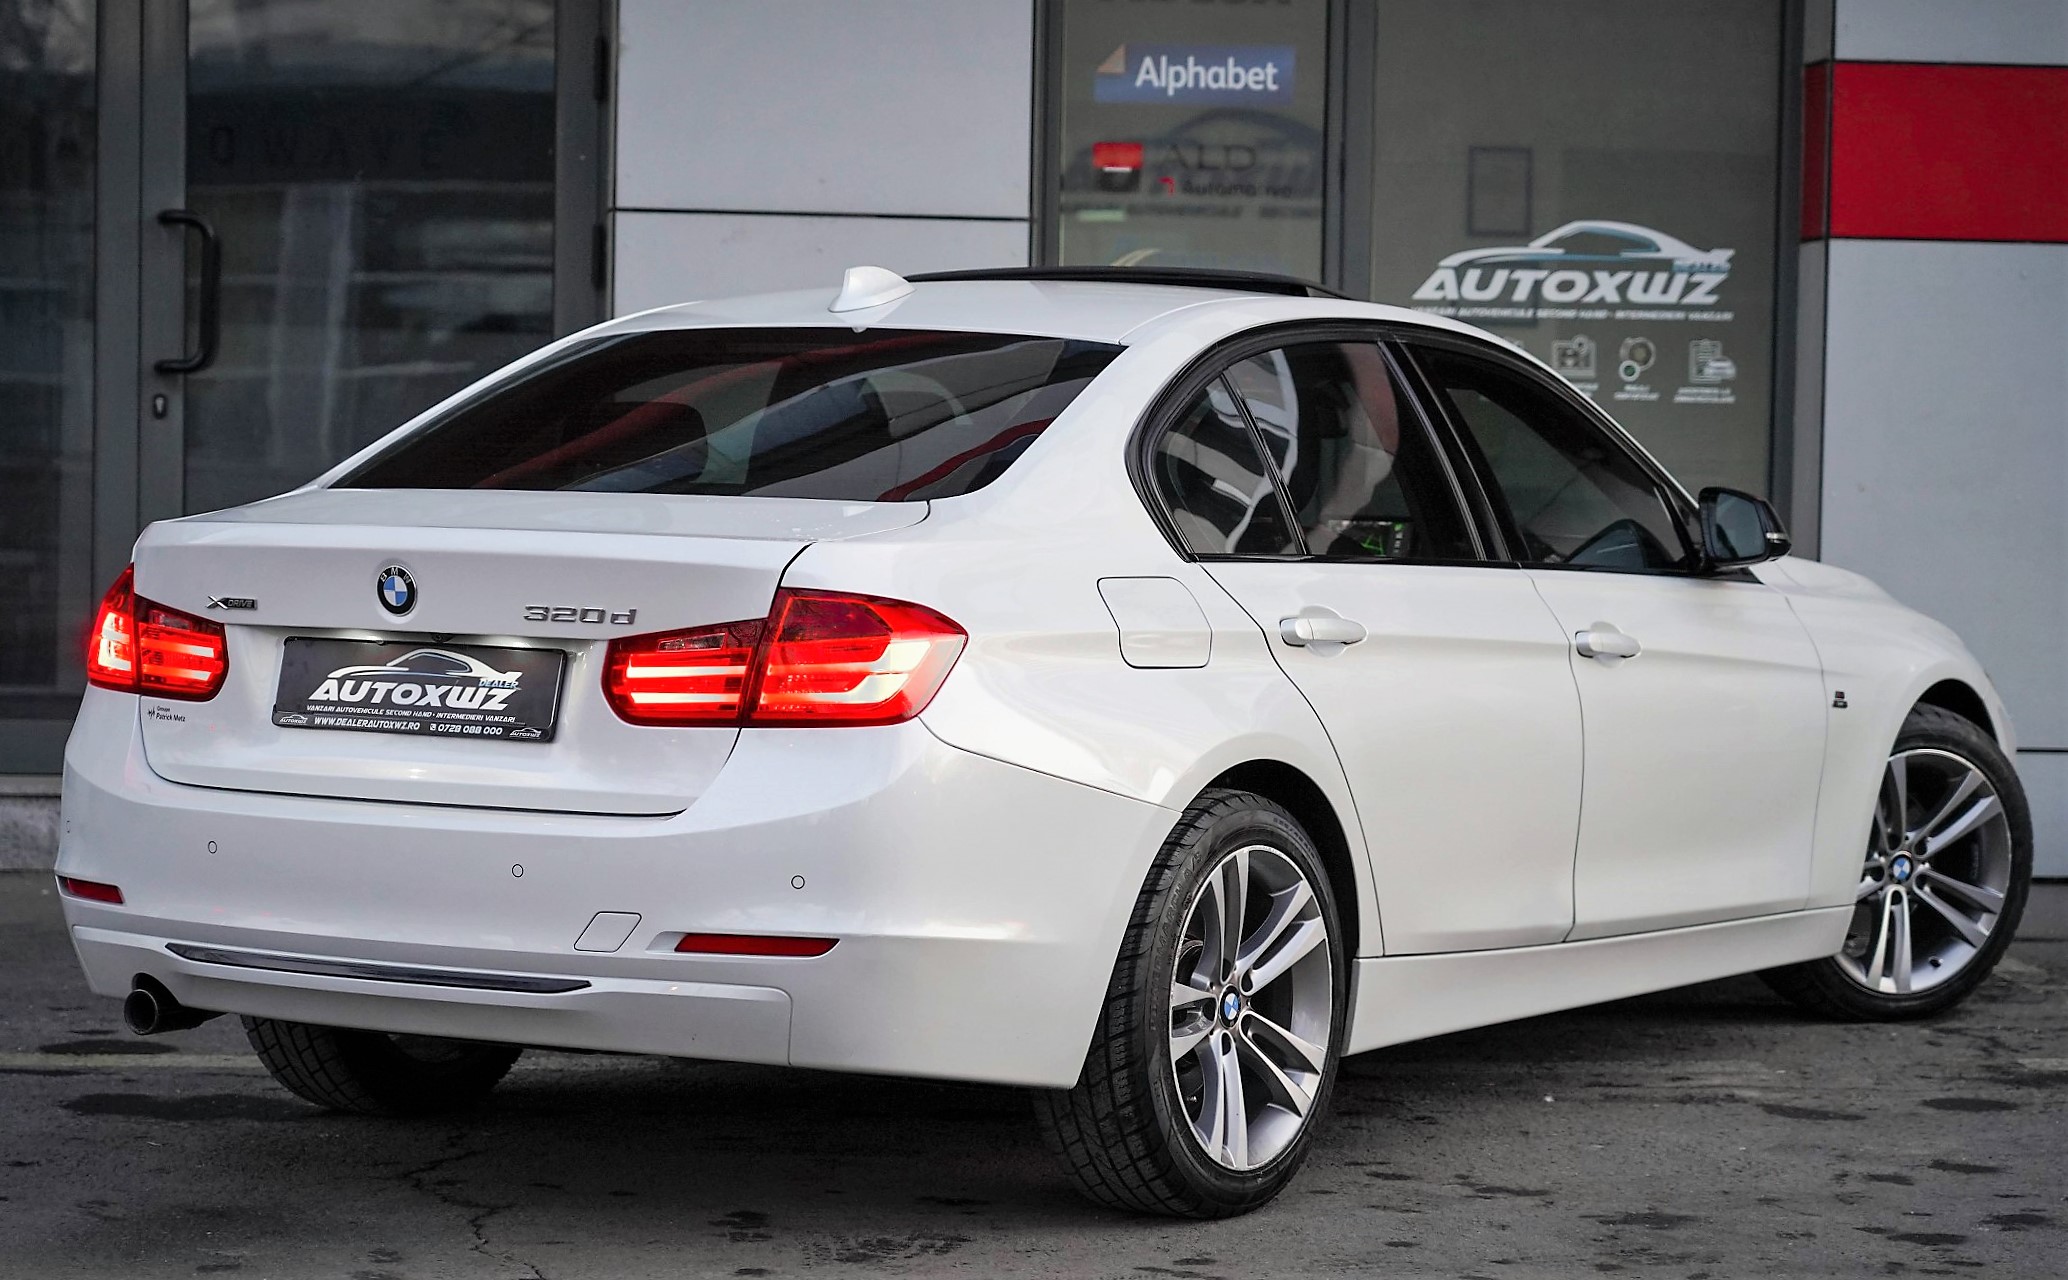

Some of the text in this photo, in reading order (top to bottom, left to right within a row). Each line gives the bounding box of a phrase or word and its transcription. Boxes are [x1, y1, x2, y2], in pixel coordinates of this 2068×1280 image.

[1134, 55, 1279, 96] Alphabet
[1412, 267, 1729, 304] AUTOXWZ
[523, 604, 637, 625] 320d
[478, 678, 519, 690] DEALER
[308, 678, 518, 711] AUTOXWZ
[306, 705, 335, 713] VANZARI
[335, 706, 385, 716] AUTOVEHICULE
[385, 709, 412, 717] SECOND
[436, 712, 483, 722] INTERMEDIERI
[484, 715, 516, 723] VANZARI
[314, 716, 420, 731] WWW.DEALERAUTOXWZ.RO
[437, 723, 503, 735] 0728 088 000
